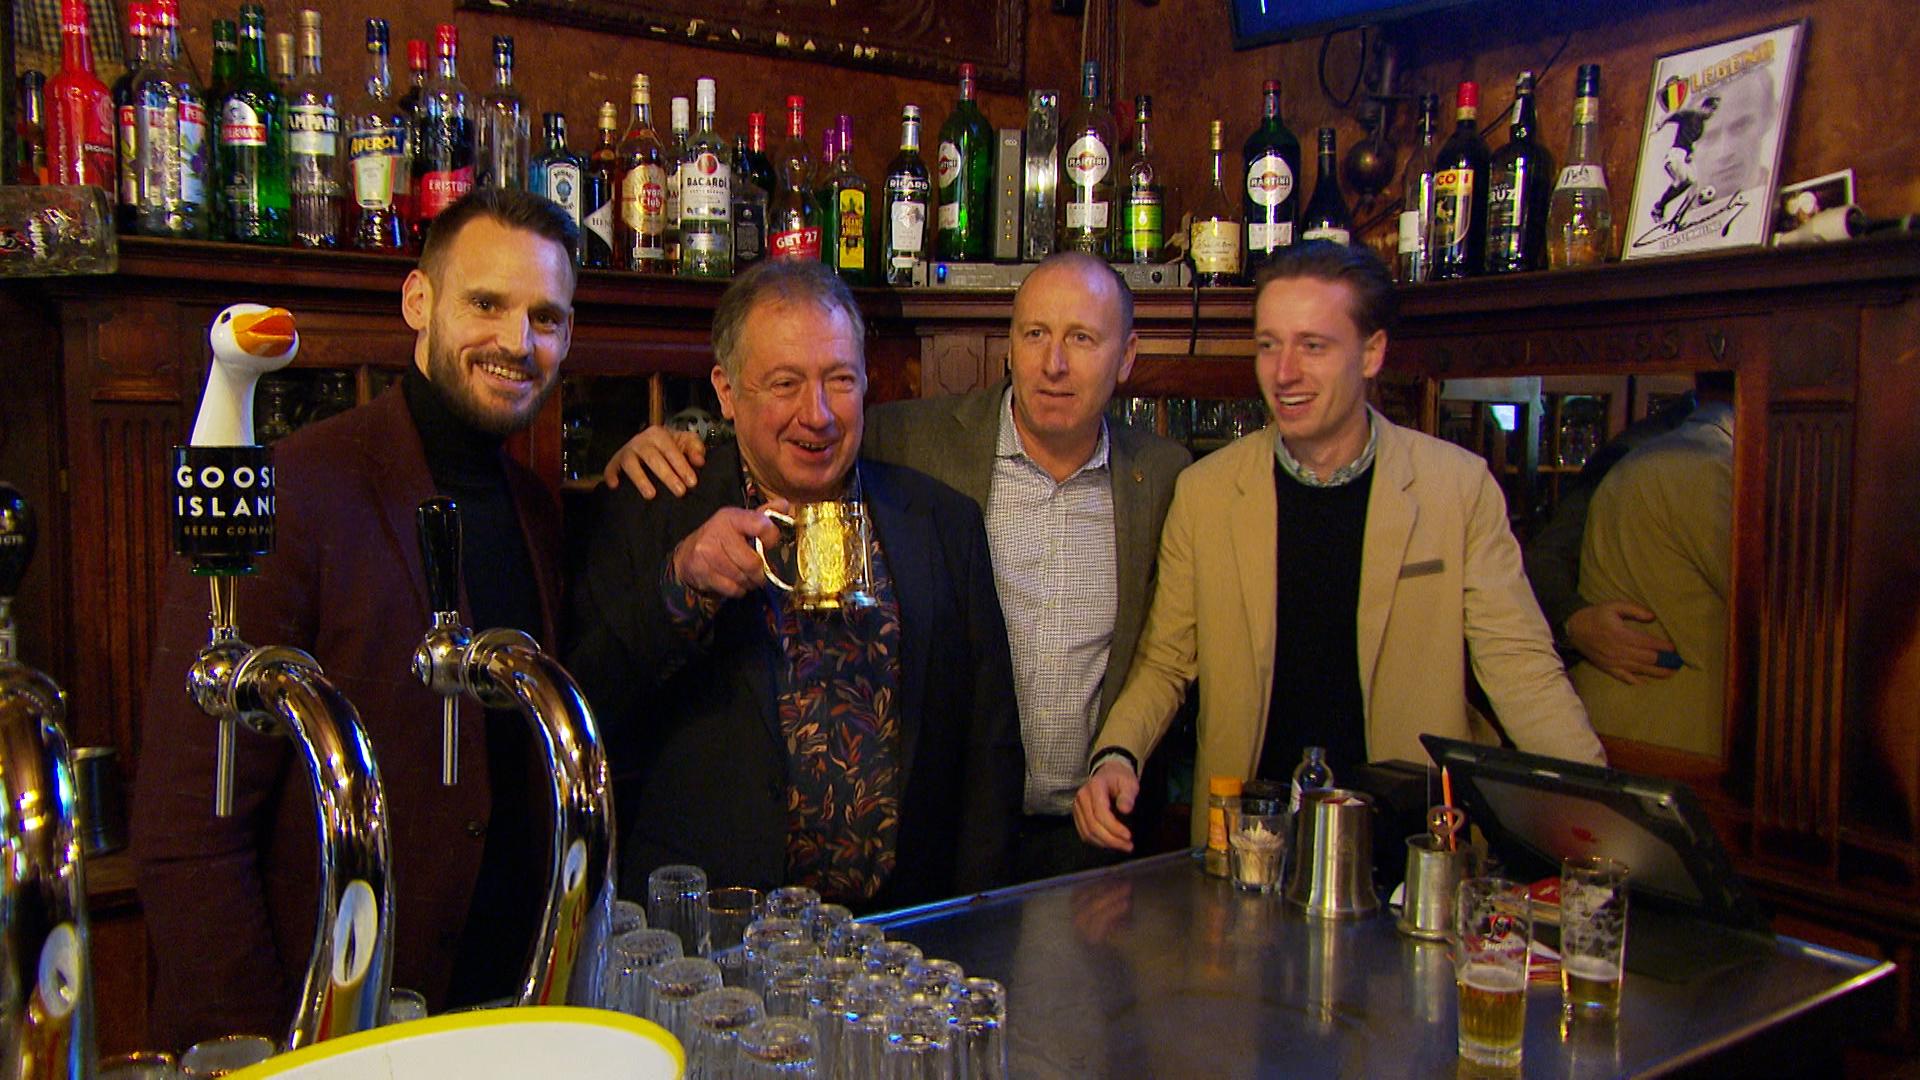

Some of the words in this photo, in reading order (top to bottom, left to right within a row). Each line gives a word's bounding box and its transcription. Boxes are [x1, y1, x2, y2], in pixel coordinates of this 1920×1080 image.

[351, 135, 399, 157] APEROL
[1068, 156, 1107, 168] MARTINI
[889, 178, 929, 191] RICARD
[1250, 175, 1290, 188] MARTINI
[776, 232, 802, 249] GET
[804, 229, 817, 244] 27
[184, 525, 218, 537] BEER
